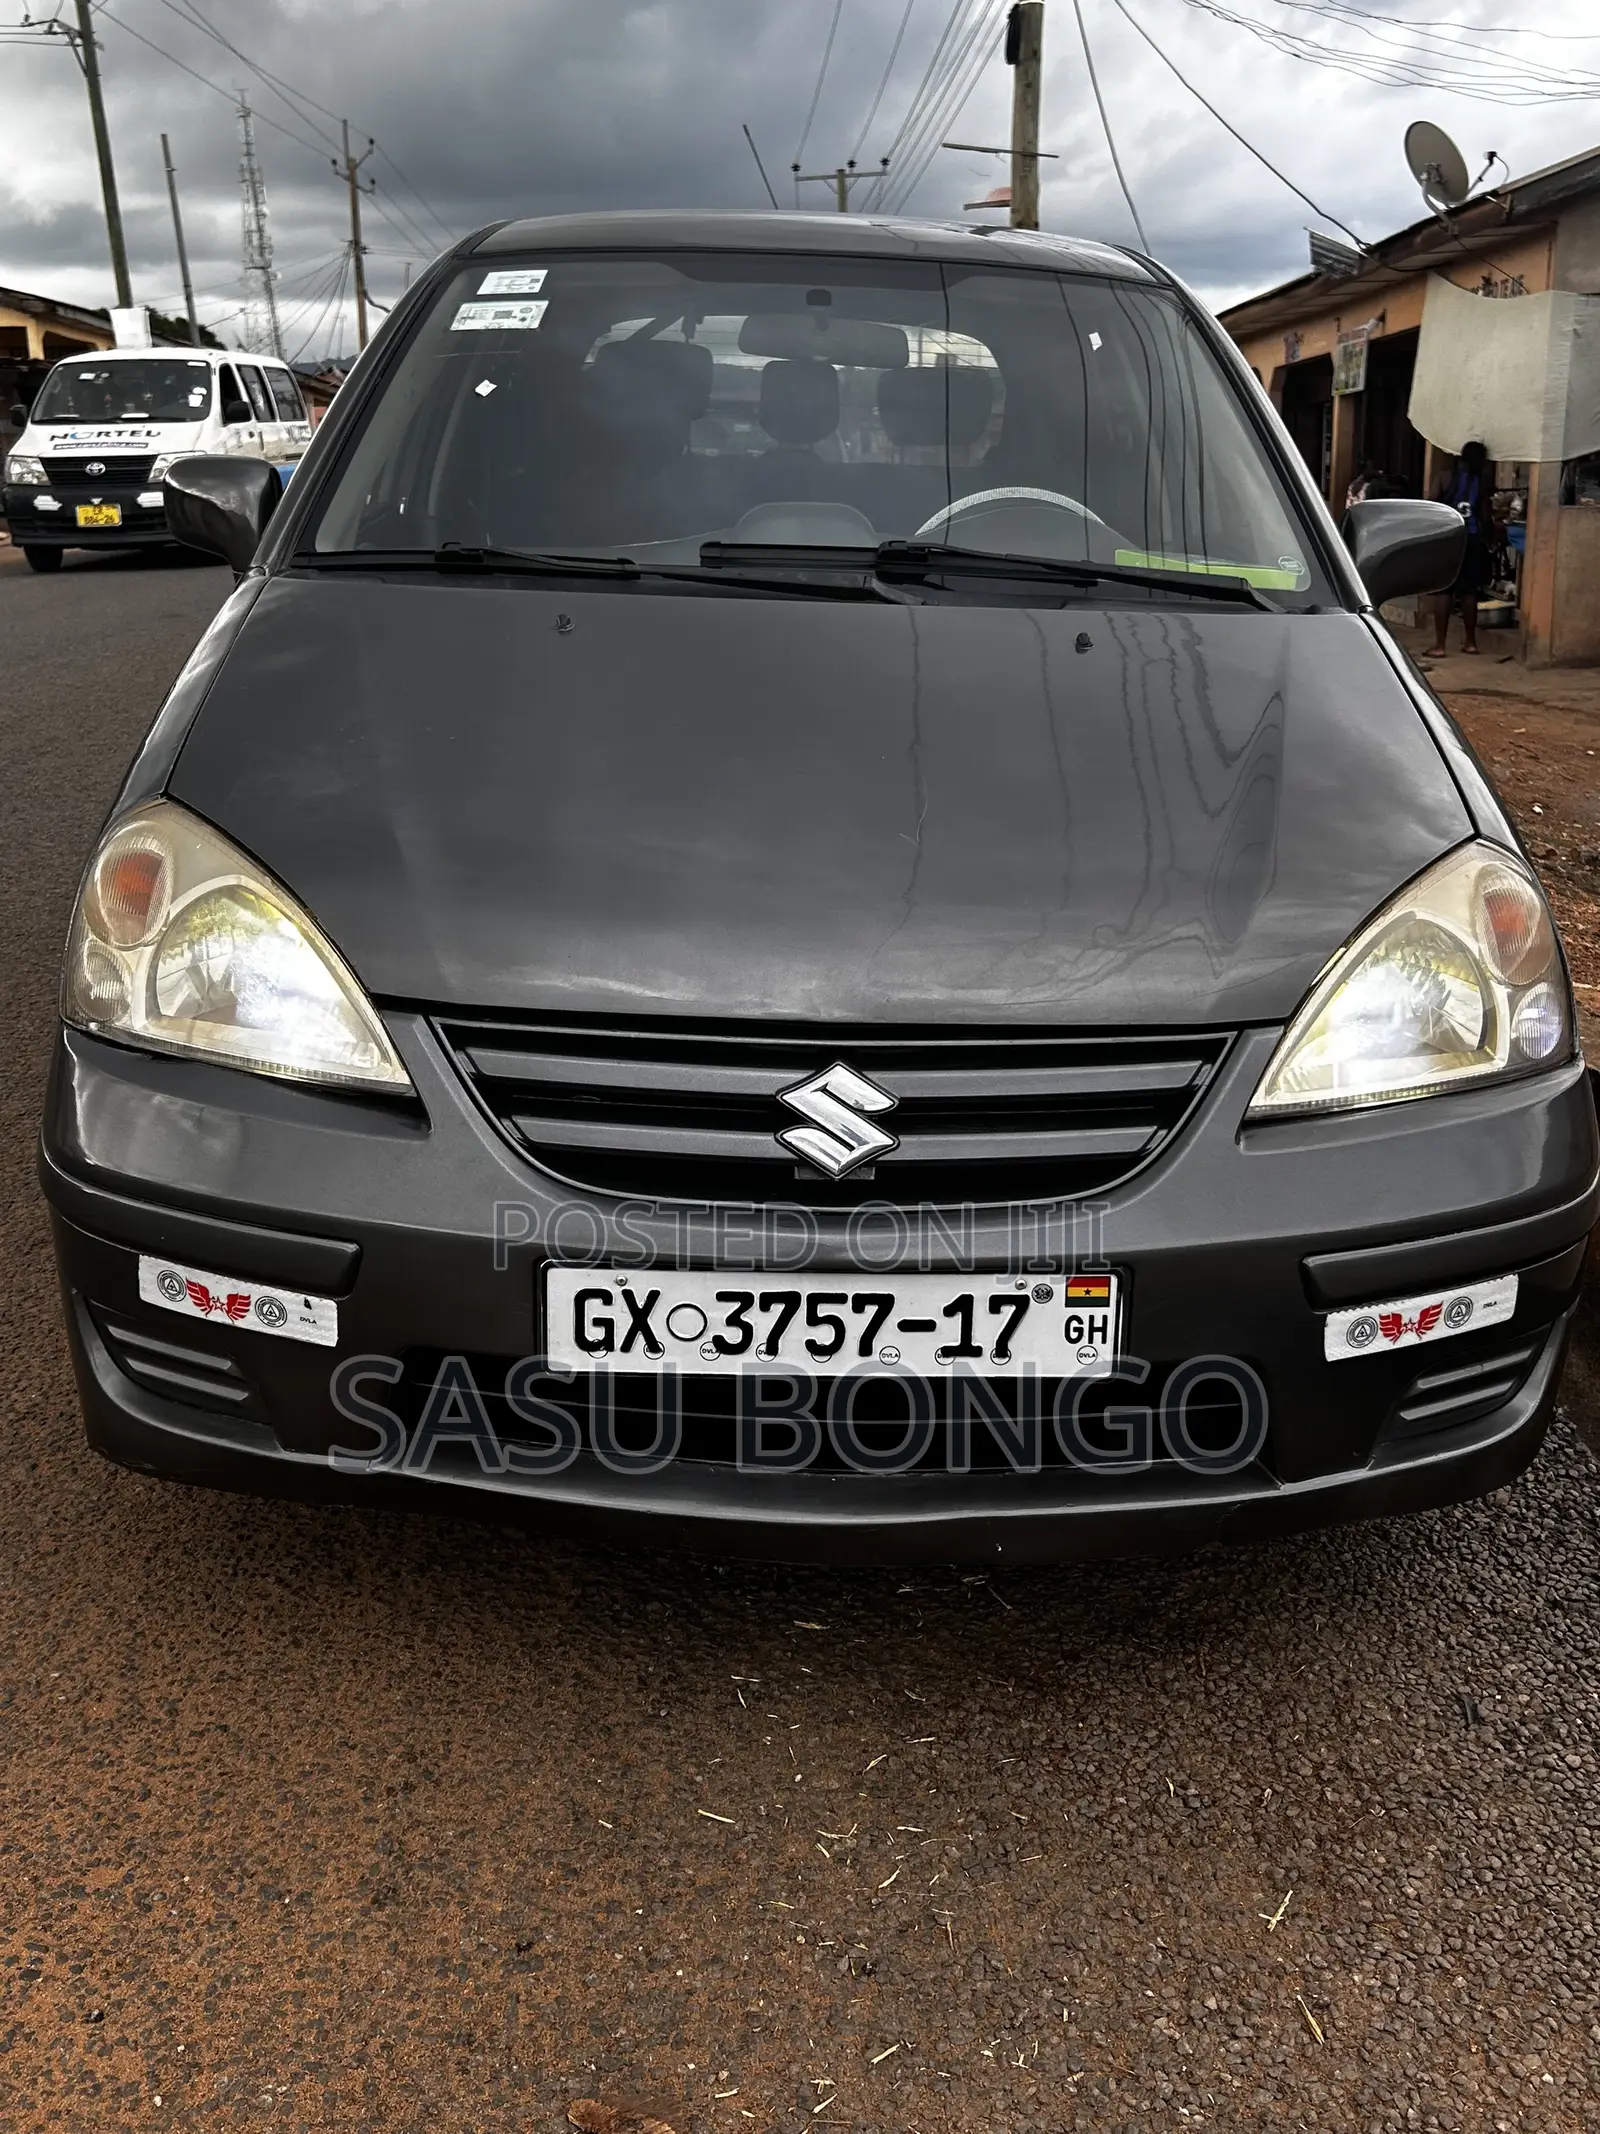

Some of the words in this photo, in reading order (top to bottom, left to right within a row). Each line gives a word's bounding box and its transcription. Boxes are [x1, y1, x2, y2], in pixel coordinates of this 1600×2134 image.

[574, 1287, 661, 1353] GX
[712, 1290, 1030, 1358] 3757-17
[1064, 1315, 1108, 1345] GH
